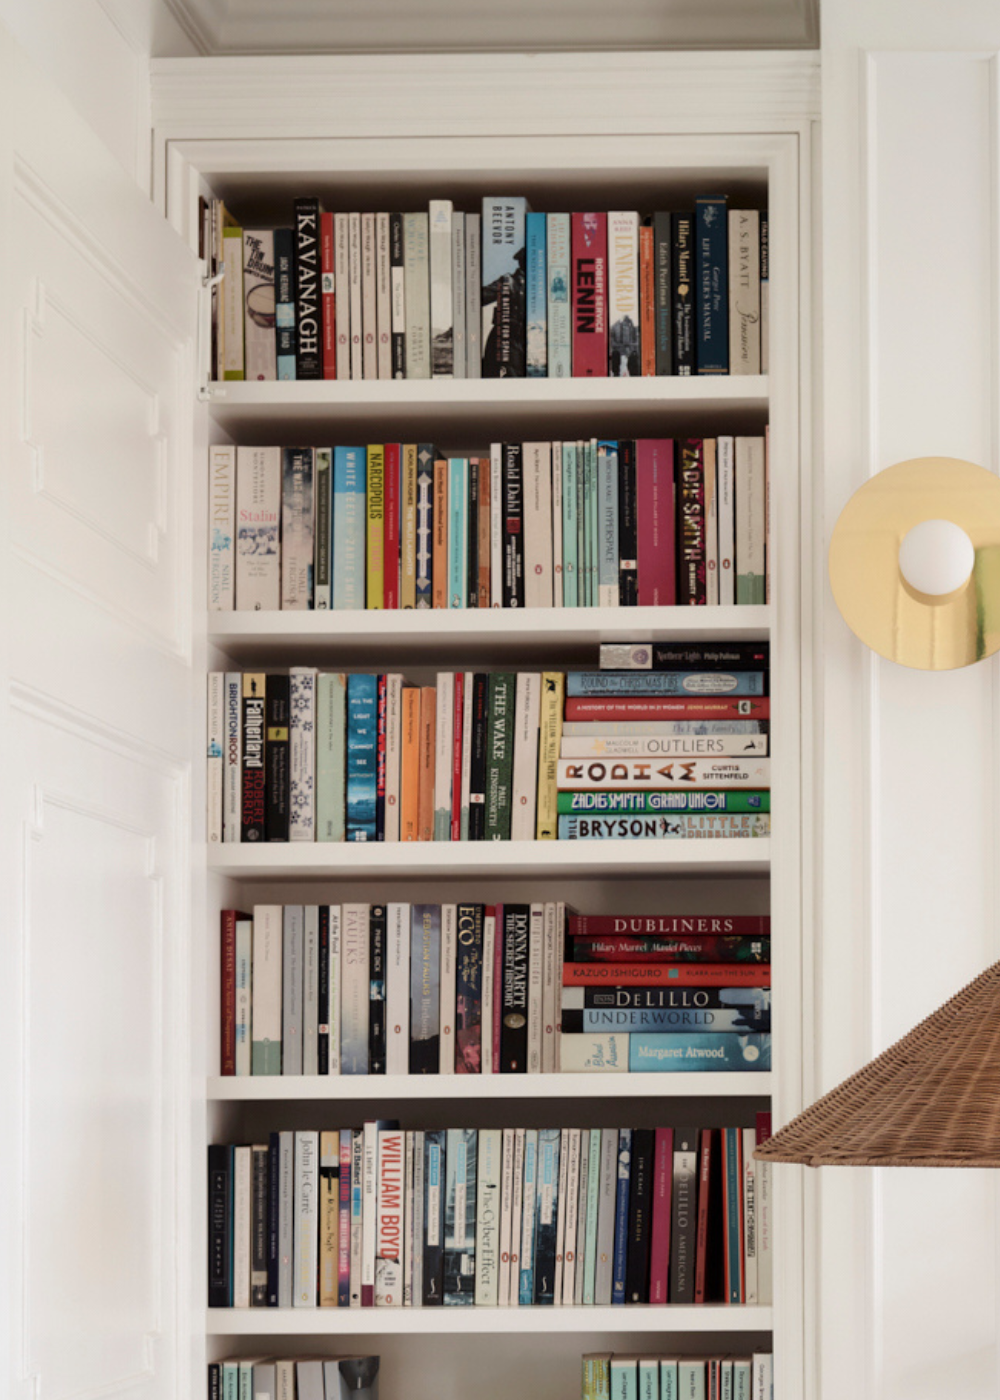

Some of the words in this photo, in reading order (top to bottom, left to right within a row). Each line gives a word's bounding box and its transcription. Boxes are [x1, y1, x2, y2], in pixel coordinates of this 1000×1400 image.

[492, 206, 503, 245] BEEVOR
[505, 206, 514, 245] ANTONY
[675, 220, 690, 249] Hilary
[660, 243, 669, 265] Edith
[678, 251, 690, 282] Mantel
[740, 246, 749, 289] BYATT
[297, 214, 317, 355] KAVANAGH
[595, 258, 604, 292] ROBERT
[615, 236, 635, 312] LENINGRAD
[577, 258, 595, 333] LENIN
[595, 295, 604, 333] SERVICE
[346, 452, 356, 486] WHITE
[507, 445, 521, 479] Roald
[683, 449, 701, 499] ZADIE
[213, 452, 231, 525] EMPIRE
[369, 453, 383, 520] NARCOPOLIS
[507, 484, 521, 512] Dahl
[240, 509, 277, 522] Stalin
[346, 491, 356, 523] TEETH
[605, 506, 613, 563] HYPERSPACE
[683, 502, 701, 560] SMITH
[212, 553, 221, 604] FERGUSON
[299, 568, 307, 594] NIALL
[493, 684, 507, 716] THE
[243, 699, 263, 767] Fatherland
[493, 718, 507, 760] WAKE
[647, 739, 724, 752] OUTLIERS
[565, 762, 696, 782] RODHAM
[243, 770, 253, 824] HARRIS
[254, 770, 264, 824] ROBERT
[489, 769, 499, 827] KINGSNORTH
[498, 786, 507, 808] PAUL
[580, 820, 656, 837] BRYSON
[687, 816, 749, 828] LITTLE
[346, 911, 358, 965] FAULKS
[359, 911, 367, 964] SEBASTIAN
[421, 913, 432, 960] SEBASTIAN
[459, 907, 475, 946] ECO
[505, 914, 515, 933] THE
[514, 914, 527, 960] DONNA
[615, 919, 733, 933] DUBLINERS
[505, 935, 515, 968] SECRET
[592, 943, 616, 953] Hilary
[618, 943, 648, 953] Mantel
[421, 962, 432, 995] FAULKS
[505, 971, 515, 1008] HISTORY
[514, 963, 527, 1008] TARTT
[573, 970, 608, 978] KAZUO
[611, 970, 661, 978] ISHIGURO
[589, 1012, 715, 1025] UNDERWORLD
[638, 1046, 683, 1060] Margaret
[685, 1046, 726, 1060] Atwood
[301, 1138, 313, 1166] John
[353, 1141, 362, 1153] JG
[301, 1170, 313, 1179] le
[353, 1155, 362, 1184] Ballard
[379, 1136, 401, 1208] WILLIAM
[301, 1181, 313, 1213] Carré
[379, 1213, 401, 1258] BOYD
[482, 1249, 494, 1284] Effect
[678, 1234, 688, 1292] AMERICANA
